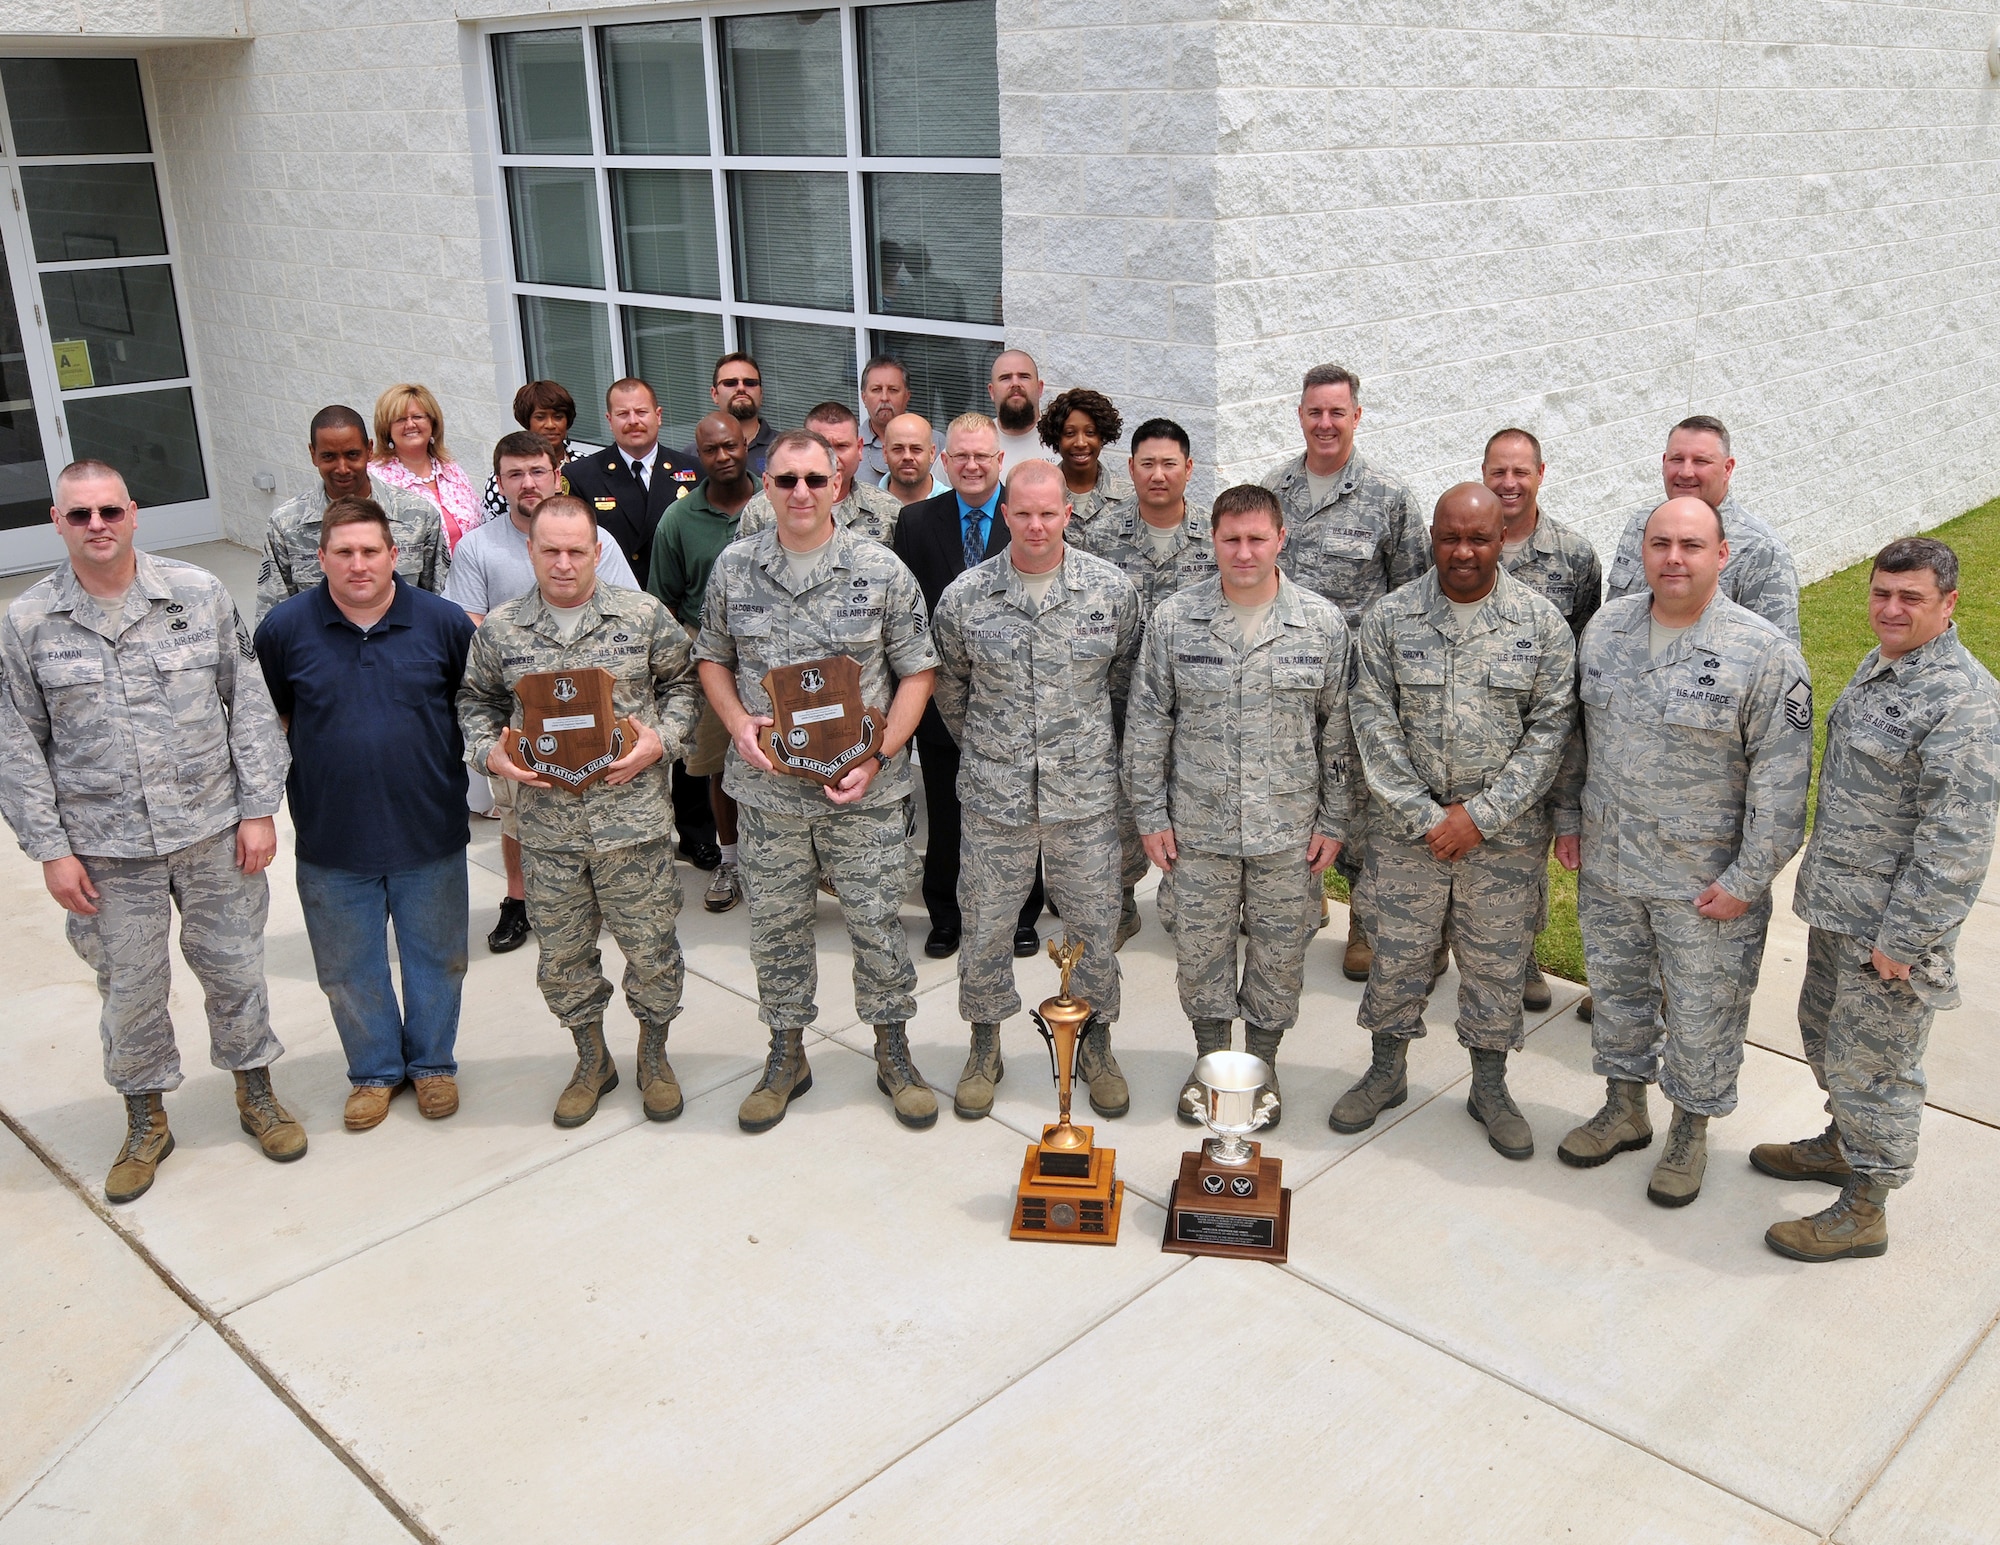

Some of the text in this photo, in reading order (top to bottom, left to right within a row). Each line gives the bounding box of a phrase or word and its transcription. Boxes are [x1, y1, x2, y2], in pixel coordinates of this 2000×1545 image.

[60, 354, 71, 368] A
[836, 608, 882, 618] U.S. AIR FORCE
[1076, 627, 1087, 635] U.S.
[1089, 627, 1099, 635] AIR
[157, 631, 211, 649] U.S. AIR FORCE
[48, 650, 82, 661] EAKMAN
[599, 645, 646, 657] U.S. AIR FORCE
[1278, 656, 1323, 665] U.S. AIR FORCE
[1497, 654, 1508, 662] U.S.
[1511, 655, 1523, 663] AIR
[1676, 688, 1730, 705] U.S. AIR FORCE
[1871, 717, 1885, 730] AIR
[1882, 723, 1908, 740] FORCE
[786, 742, 866, 776] AIR NATIONAL GUARD
[533, 754, 614, 783] AIR NATIONAL GUARD
